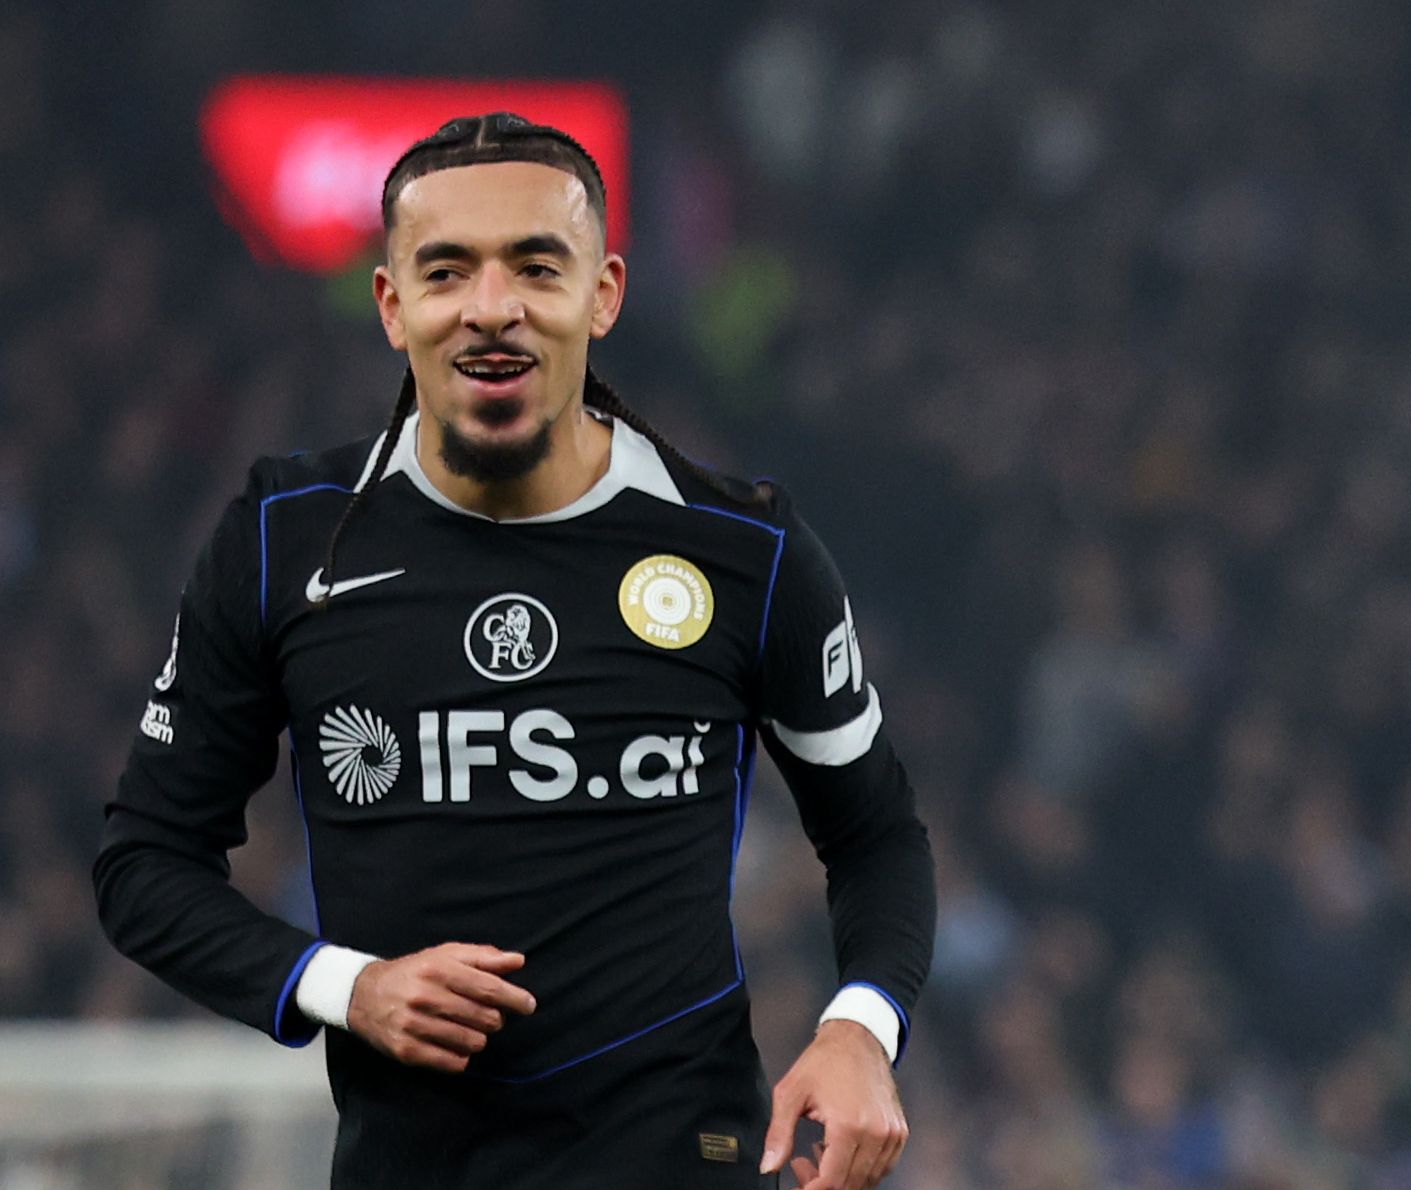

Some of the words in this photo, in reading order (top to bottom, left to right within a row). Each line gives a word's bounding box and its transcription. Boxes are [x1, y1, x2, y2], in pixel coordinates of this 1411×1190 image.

[628, 566, 656, 606] WORLD
[657, 564, 706, 621] CHAMPIONS
[645, 622, 680, 642] FIFA
